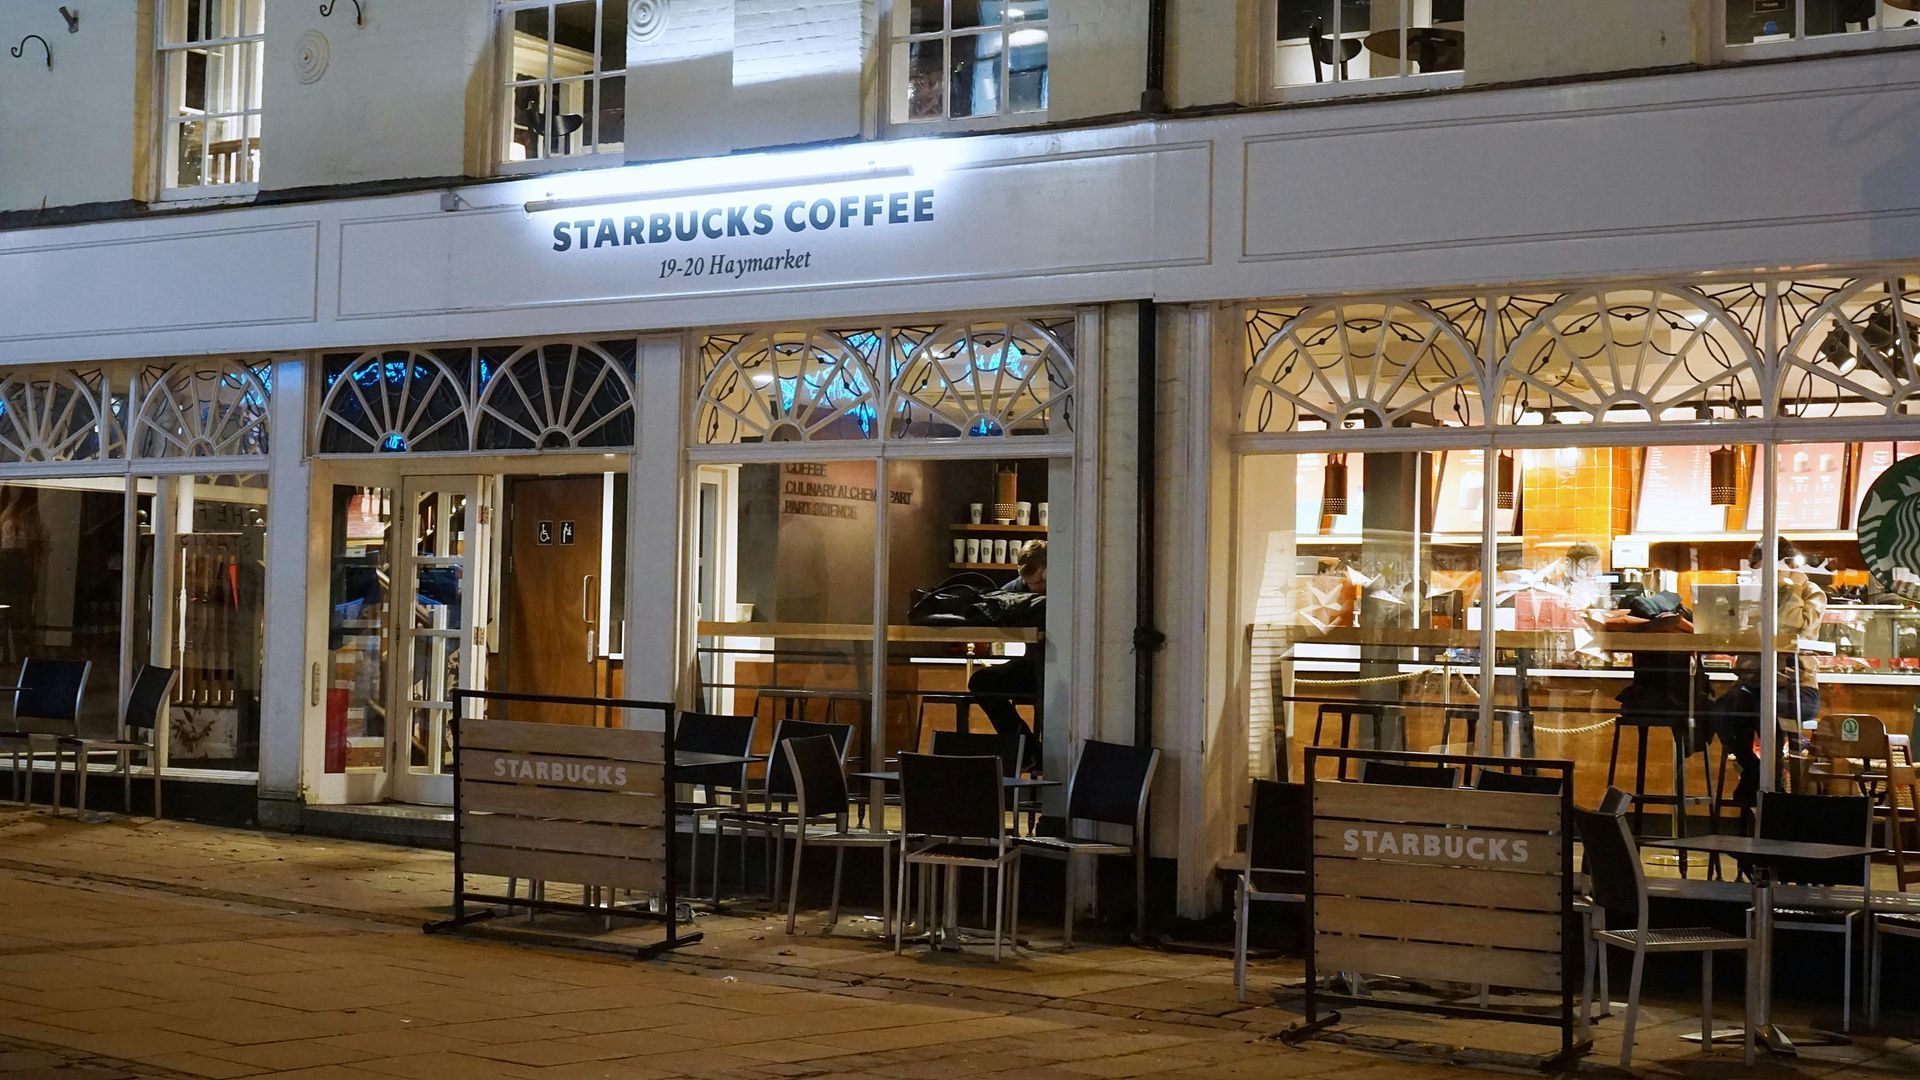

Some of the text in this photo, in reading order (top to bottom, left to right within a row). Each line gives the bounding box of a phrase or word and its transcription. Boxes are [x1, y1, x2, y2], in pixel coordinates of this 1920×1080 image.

[552, 189, 935, 252] STARBUCKS COFFEE
[659, 249, 812, 279] 19-20 Haymarket
[785, 480, 837, 498] CULINARY
[784, 500, 858, 519] PART SCIENCE
[494, 758, 627, 786] STARBUCKS
[1343, 829, 1529, 863] STARBUCKS
